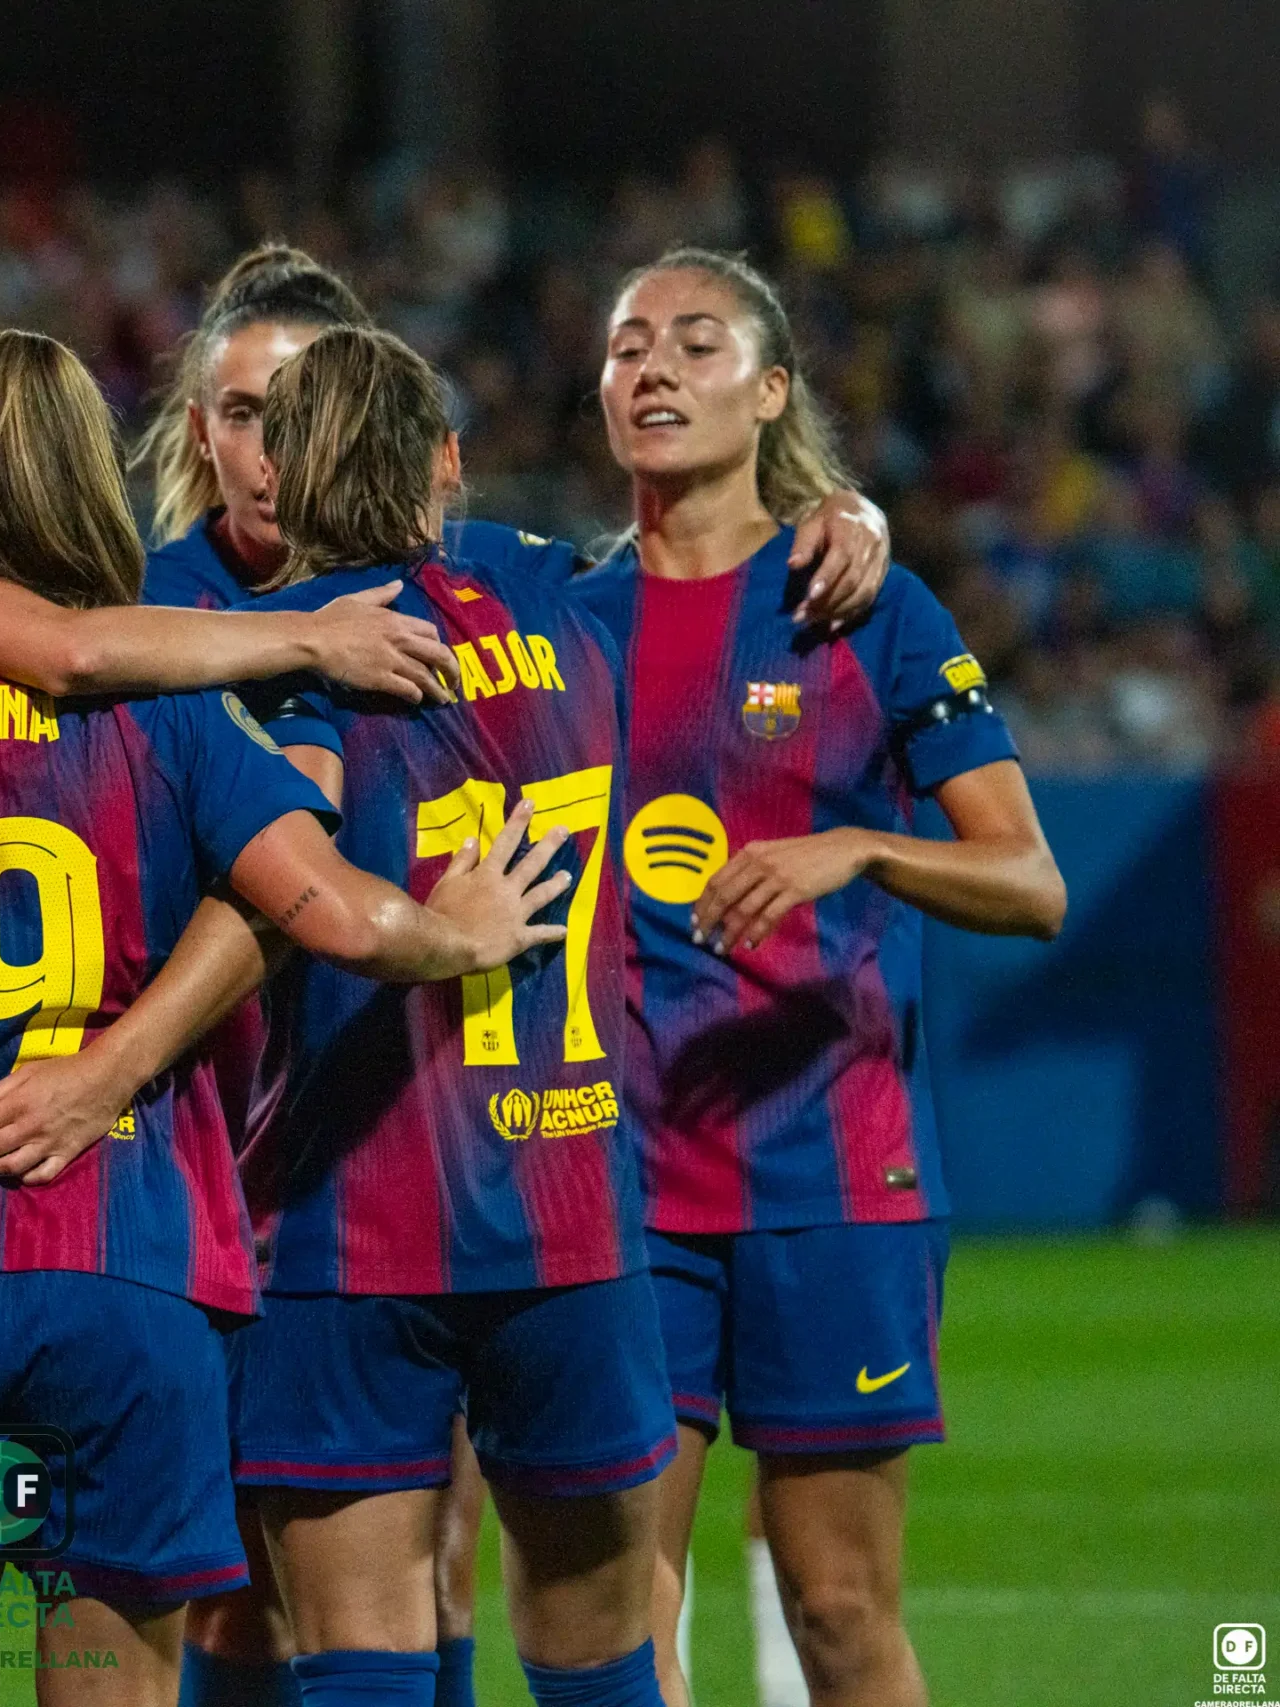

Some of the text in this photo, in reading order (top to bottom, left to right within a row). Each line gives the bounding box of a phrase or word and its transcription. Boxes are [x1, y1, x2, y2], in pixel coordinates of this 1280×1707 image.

[435, 629, 566, 703] AJOR
[542, 1081, 616, 1109] UNHCR
[540, 1099, 620, 1131] ACNUR
